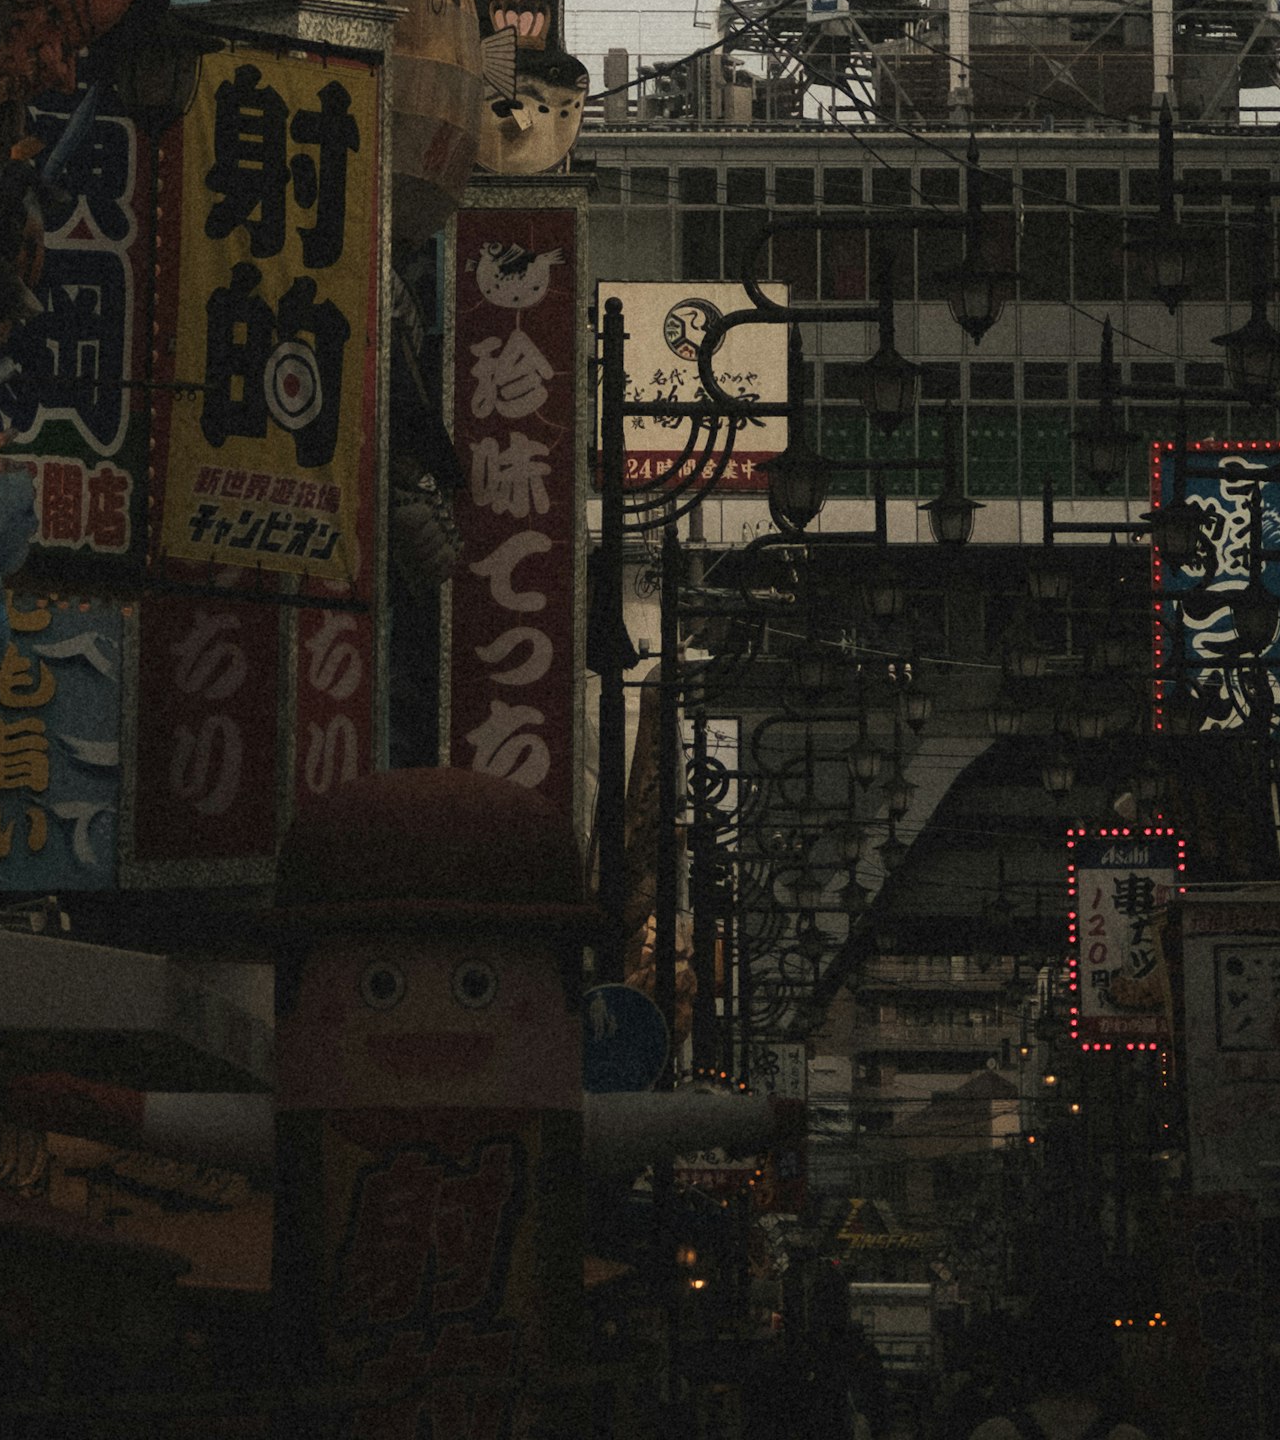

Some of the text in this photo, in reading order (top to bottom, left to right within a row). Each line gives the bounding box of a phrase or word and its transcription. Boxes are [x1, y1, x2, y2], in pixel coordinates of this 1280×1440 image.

[193, 467, 352, 514] 新世界遊技場
[190, 504, 352, 560] チャンピオン
[1099, 846, 1151, 867] Asahi
